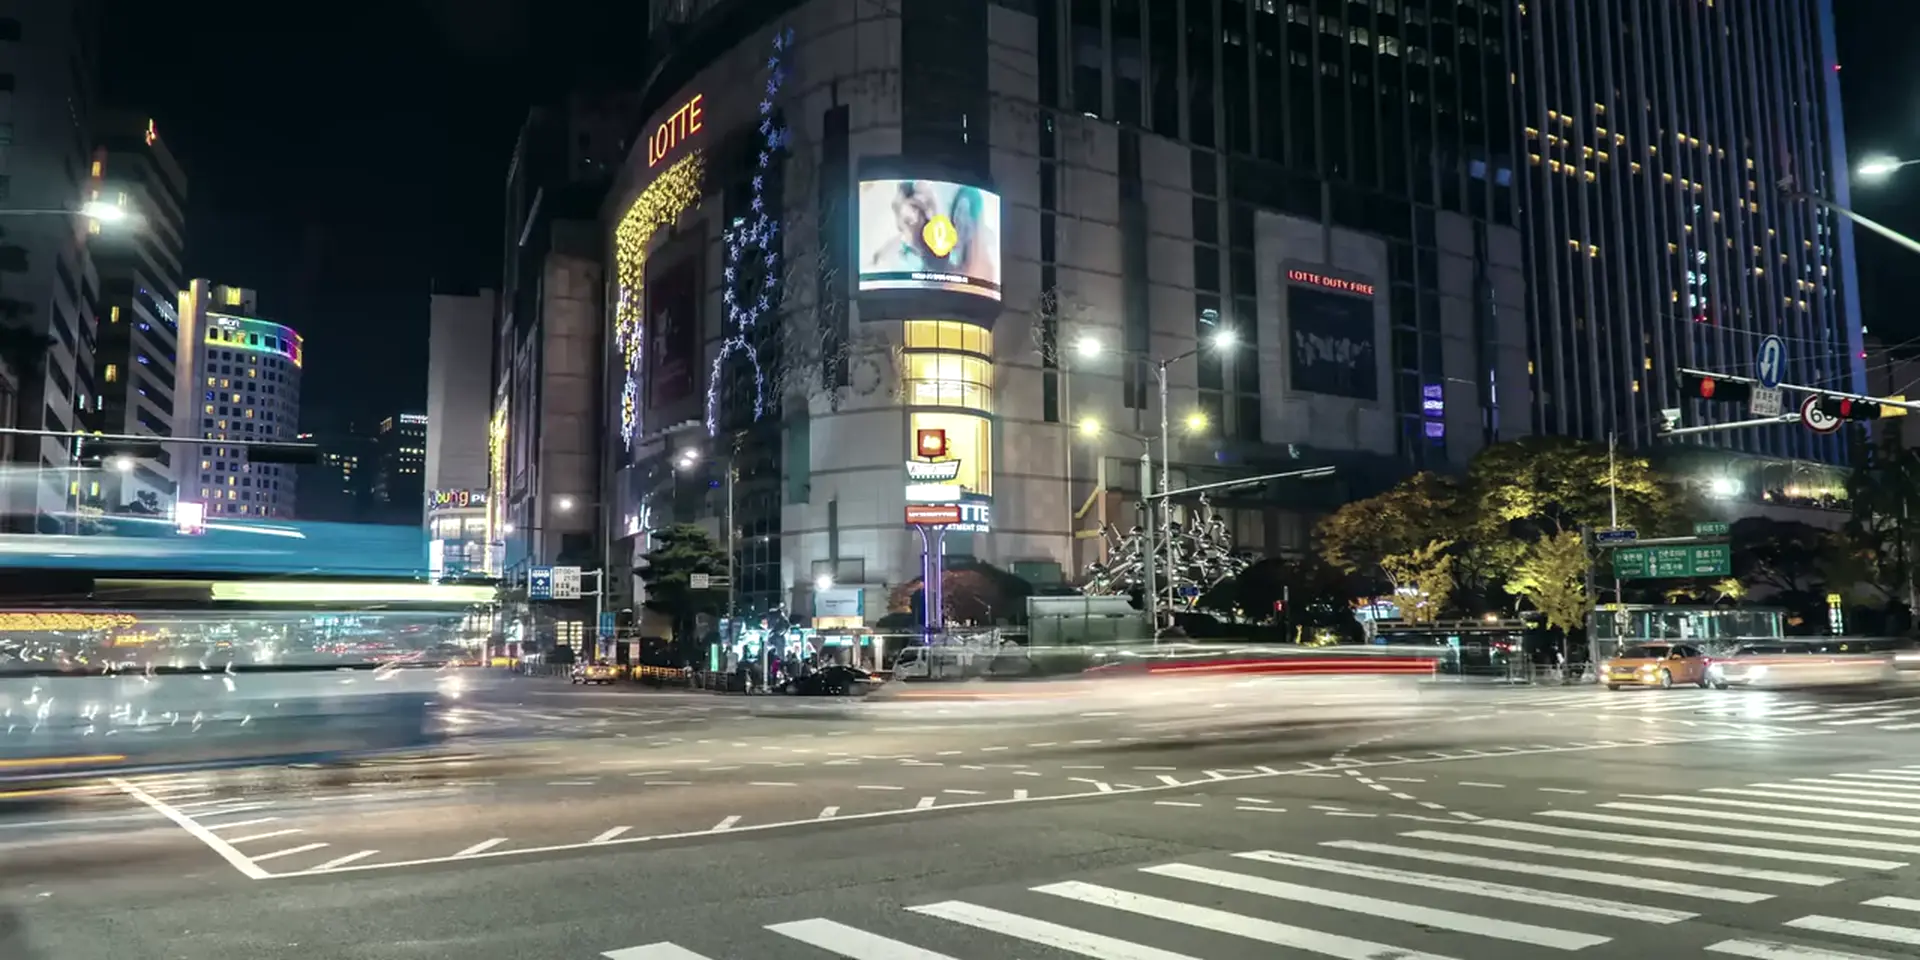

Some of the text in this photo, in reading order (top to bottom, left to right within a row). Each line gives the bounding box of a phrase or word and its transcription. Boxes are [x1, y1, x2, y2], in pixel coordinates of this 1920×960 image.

[649, 93, 702, 167] LOTTE
[1288, 269, 1375, 295] LOTTE DUTY FREE
[1811, 406, 1835, 423] 6
